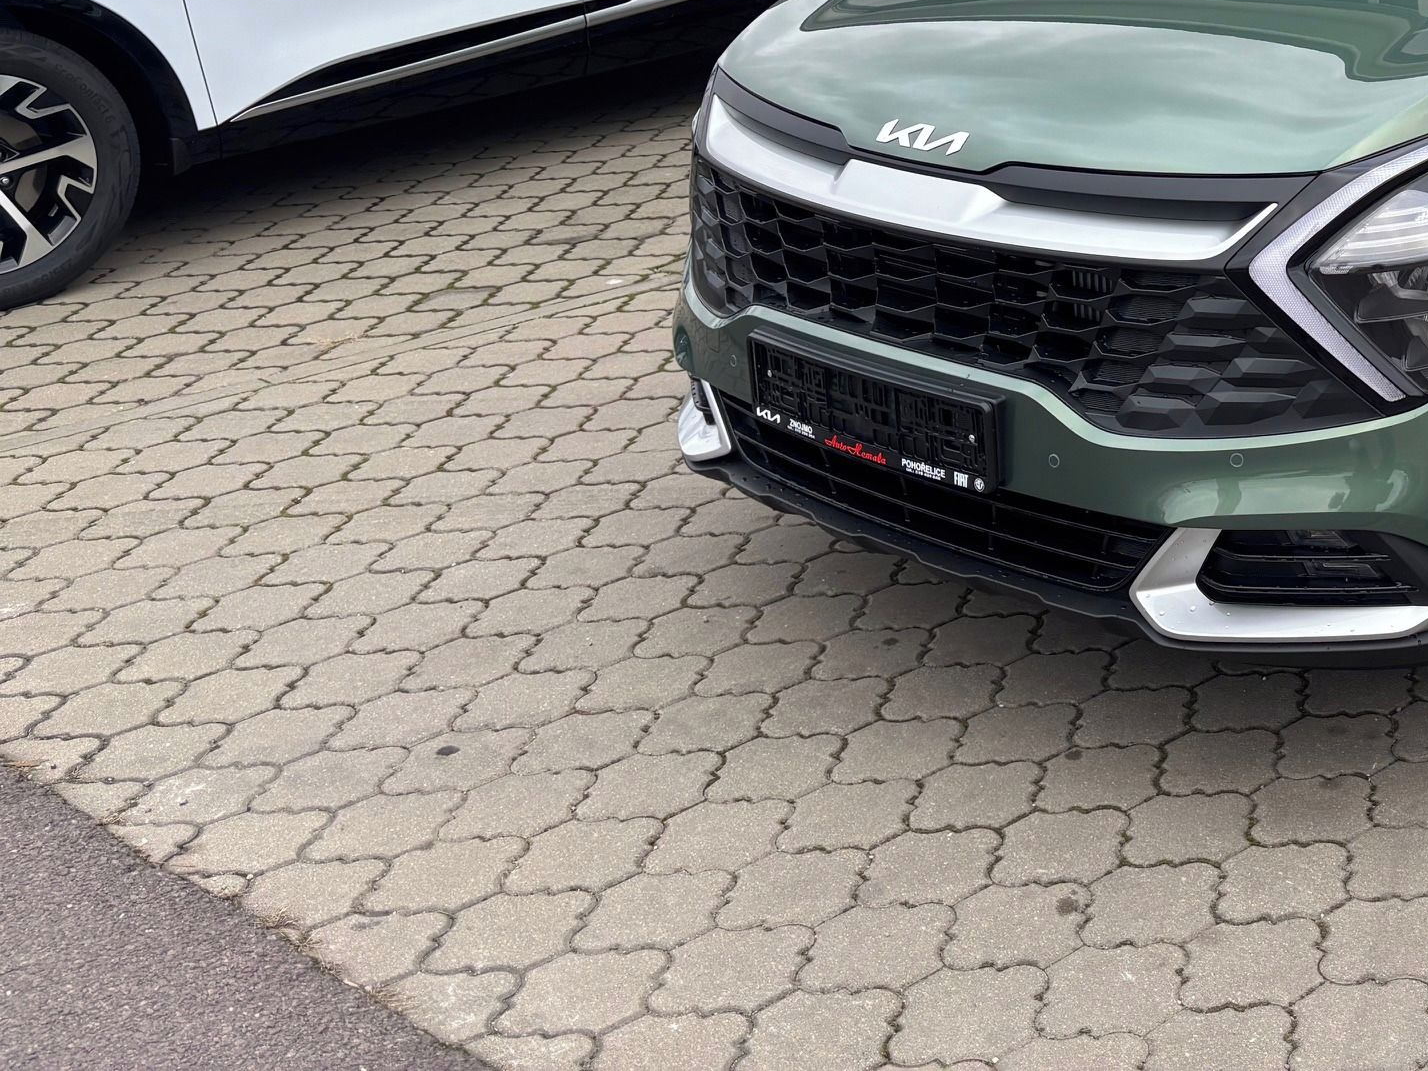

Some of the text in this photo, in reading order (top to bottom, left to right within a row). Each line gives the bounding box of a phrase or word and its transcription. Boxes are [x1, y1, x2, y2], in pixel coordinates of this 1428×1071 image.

[876, 118, 970, 156] KIA
[756, 407, 780, 424] KIA
[901, 458, 946, 479] POHOŘELICE
[953, 471, 969, 488] FIAT
